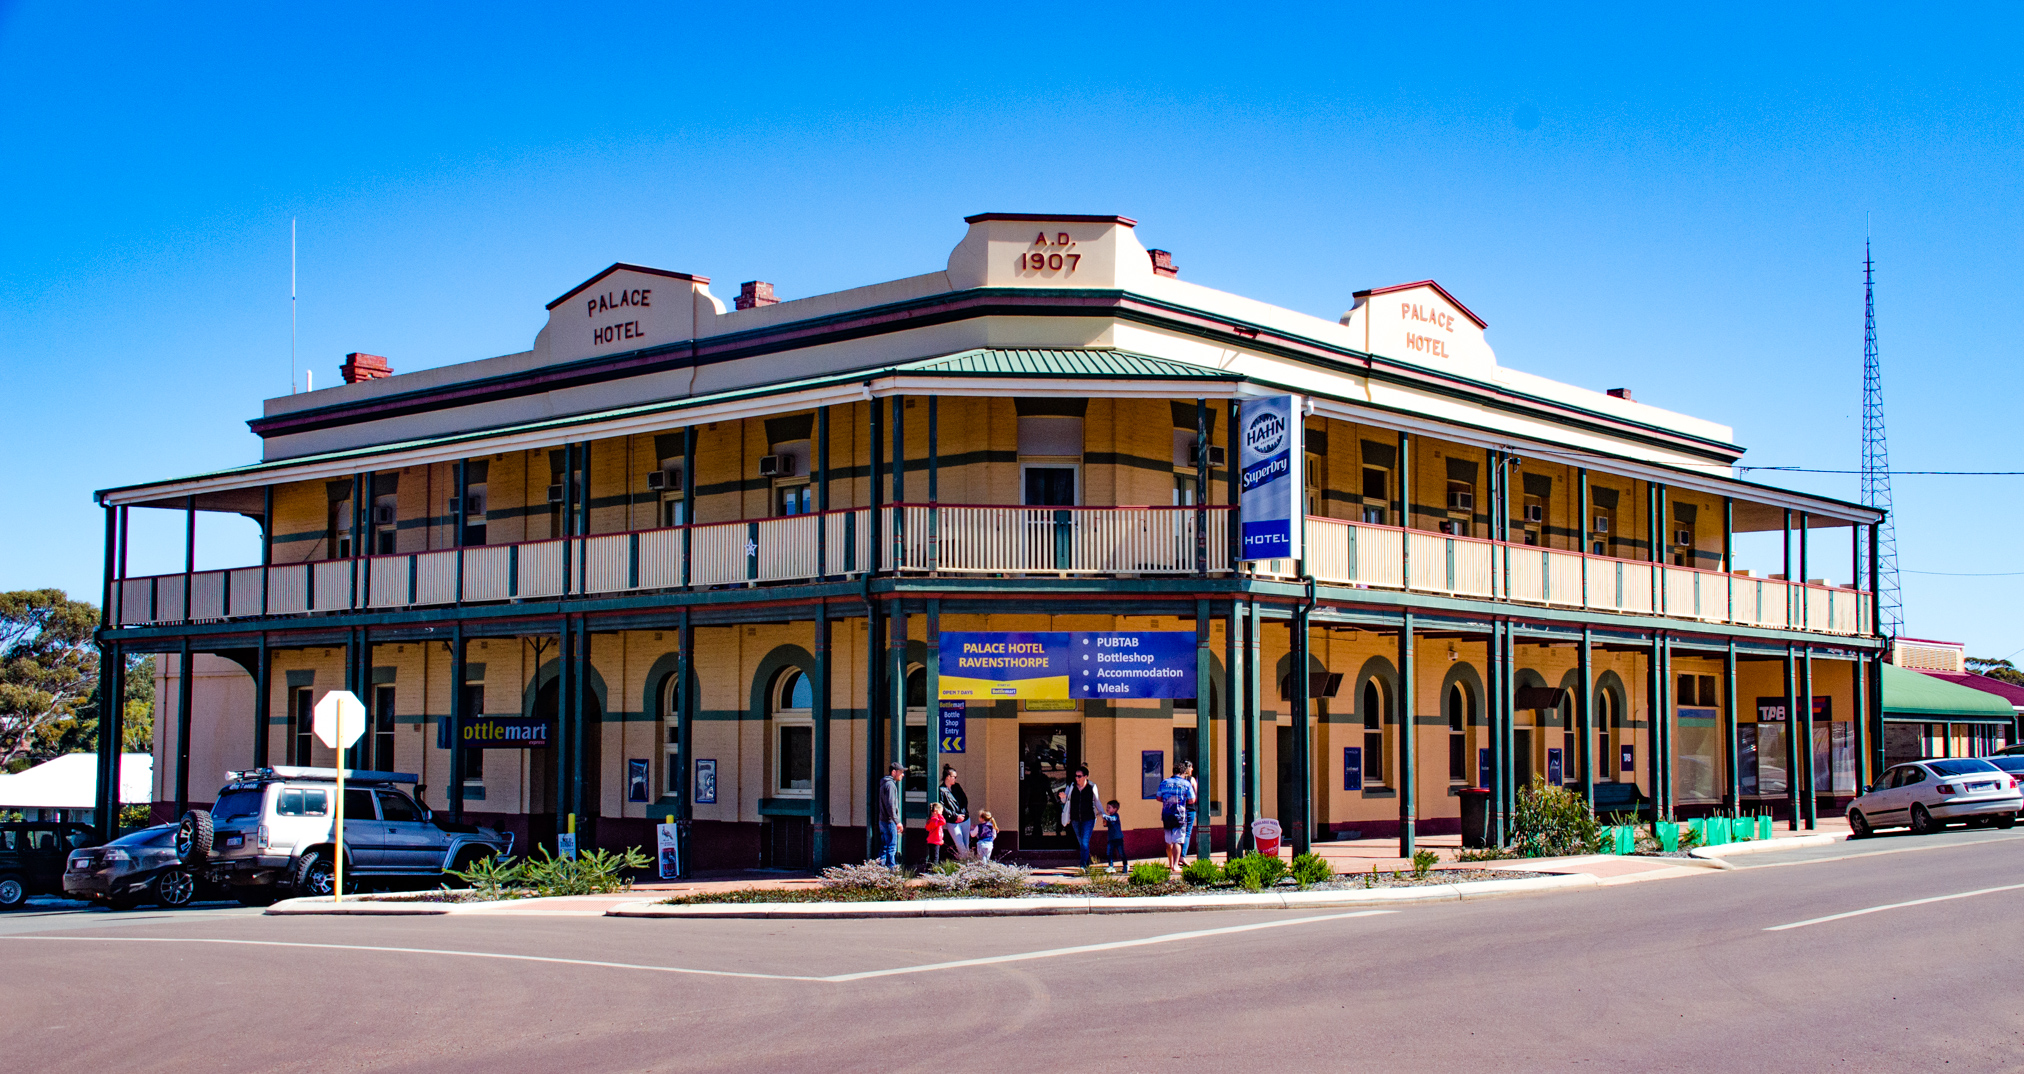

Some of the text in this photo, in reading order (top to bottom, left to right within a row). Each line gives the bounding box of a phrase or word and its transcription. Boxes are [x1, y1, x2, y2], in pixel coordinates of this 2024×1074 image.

[1034, 231, 1076, 246] A.D.
[1022, 253, 1081, 272] 1907
[587, 289, 652, 318] PALACE
[1401, 302, 1455, 333] PALACE
[594, 320, 645, 346] HOTEL
[1406, 331, 1449, 359] HOTEL
[1246, 416, 1285, 447] HAHN
[1244, 533, 1289, 545] HOTEL
[963, 643, 1045, 654] PALACE HOTEL
[1097, 637, 1139, 648] PUBTAB
[959, 657, 1049, 668] RAVENSTHORPE
[1097, 652, 1155, 664] Bottleshop
[1097, 667, 1184, 678] Accommodation
[1097, 682, 1130, 693] Meals
[1758, 706, 1786, 721] TAB
[463, 720, 547, 740] ottlemart
